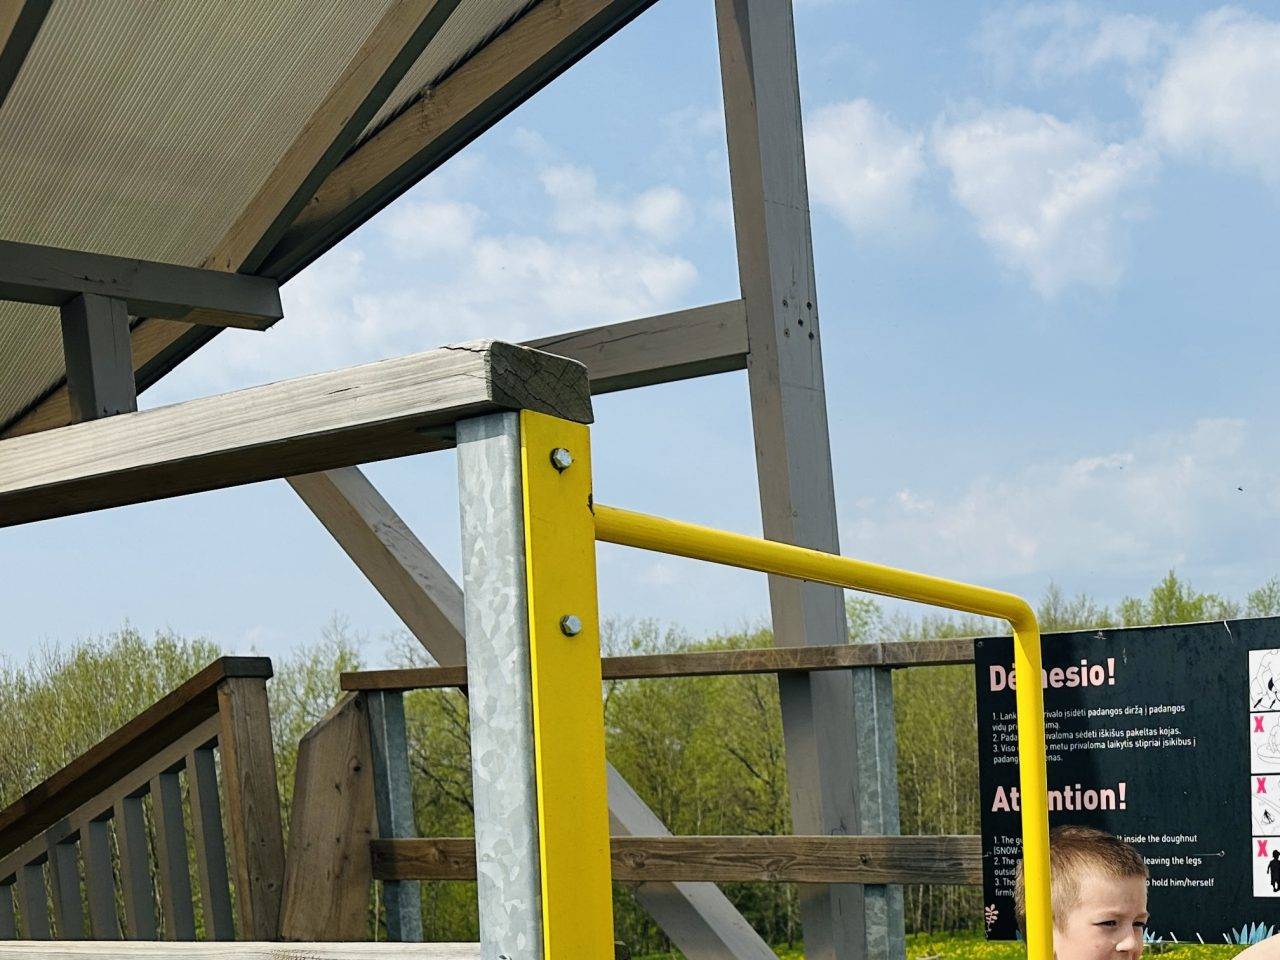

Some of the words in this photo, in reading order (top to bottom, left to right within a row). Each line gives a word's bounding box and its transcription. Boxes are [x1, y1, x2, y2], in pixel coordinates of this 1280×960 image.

[992, 712, 999, 720] 1.
[1087, 707, 1123, 718] padangos
[1124, 705, 1143, 716] diržą
[1149, 704, 1186, 716] padangos
[992, 733, 999, 742] 2.
[1045, 731, 1073, 740] ivaloma
[1098, 728, 1124, 738] iškišus
[1126, 727, 1158, 738] pakeltas
[1159, 725, 1182, 737] kojas.
[993, 744, 999, 753] 3.
[1000, 744, 1016, 752] Viso
[1069, 741, 1106, 751] privaloma
[1107, 739, 1134, 750] laikytis
[1134, 738, 1161, 749] stipriai
[1162, 737, 1192, 748] įsikibus
[993, 755, 1019, 764] padang
[991, 782, 1126, 812] Atntion!
[993, 836, 1000, 844] 1.
[1001, 835, 1015, 844] The
[1123, 834, 1146, 843] inside
[1147, 833, 1160, 843] the
[1161, 834, 1197, 844] doughnut
[993, 846, 1022, 855] (SNOW-
[993, 857, 1000, 865] 2.
[1001, 856, 1016, 865] The
[1143, 856, 1170, 867] leaving
[1171, 857, 1184, 865] the
[1185, 856, 1202, 867] legs
[994, 867, 1016, 876] outsid
[994, 877, 1000, 886] 3.
[1002, 877, 1016, 886] The
[1151, 878, 1168, 887] hold
[1169, 876, 1215, 887] him/herself
